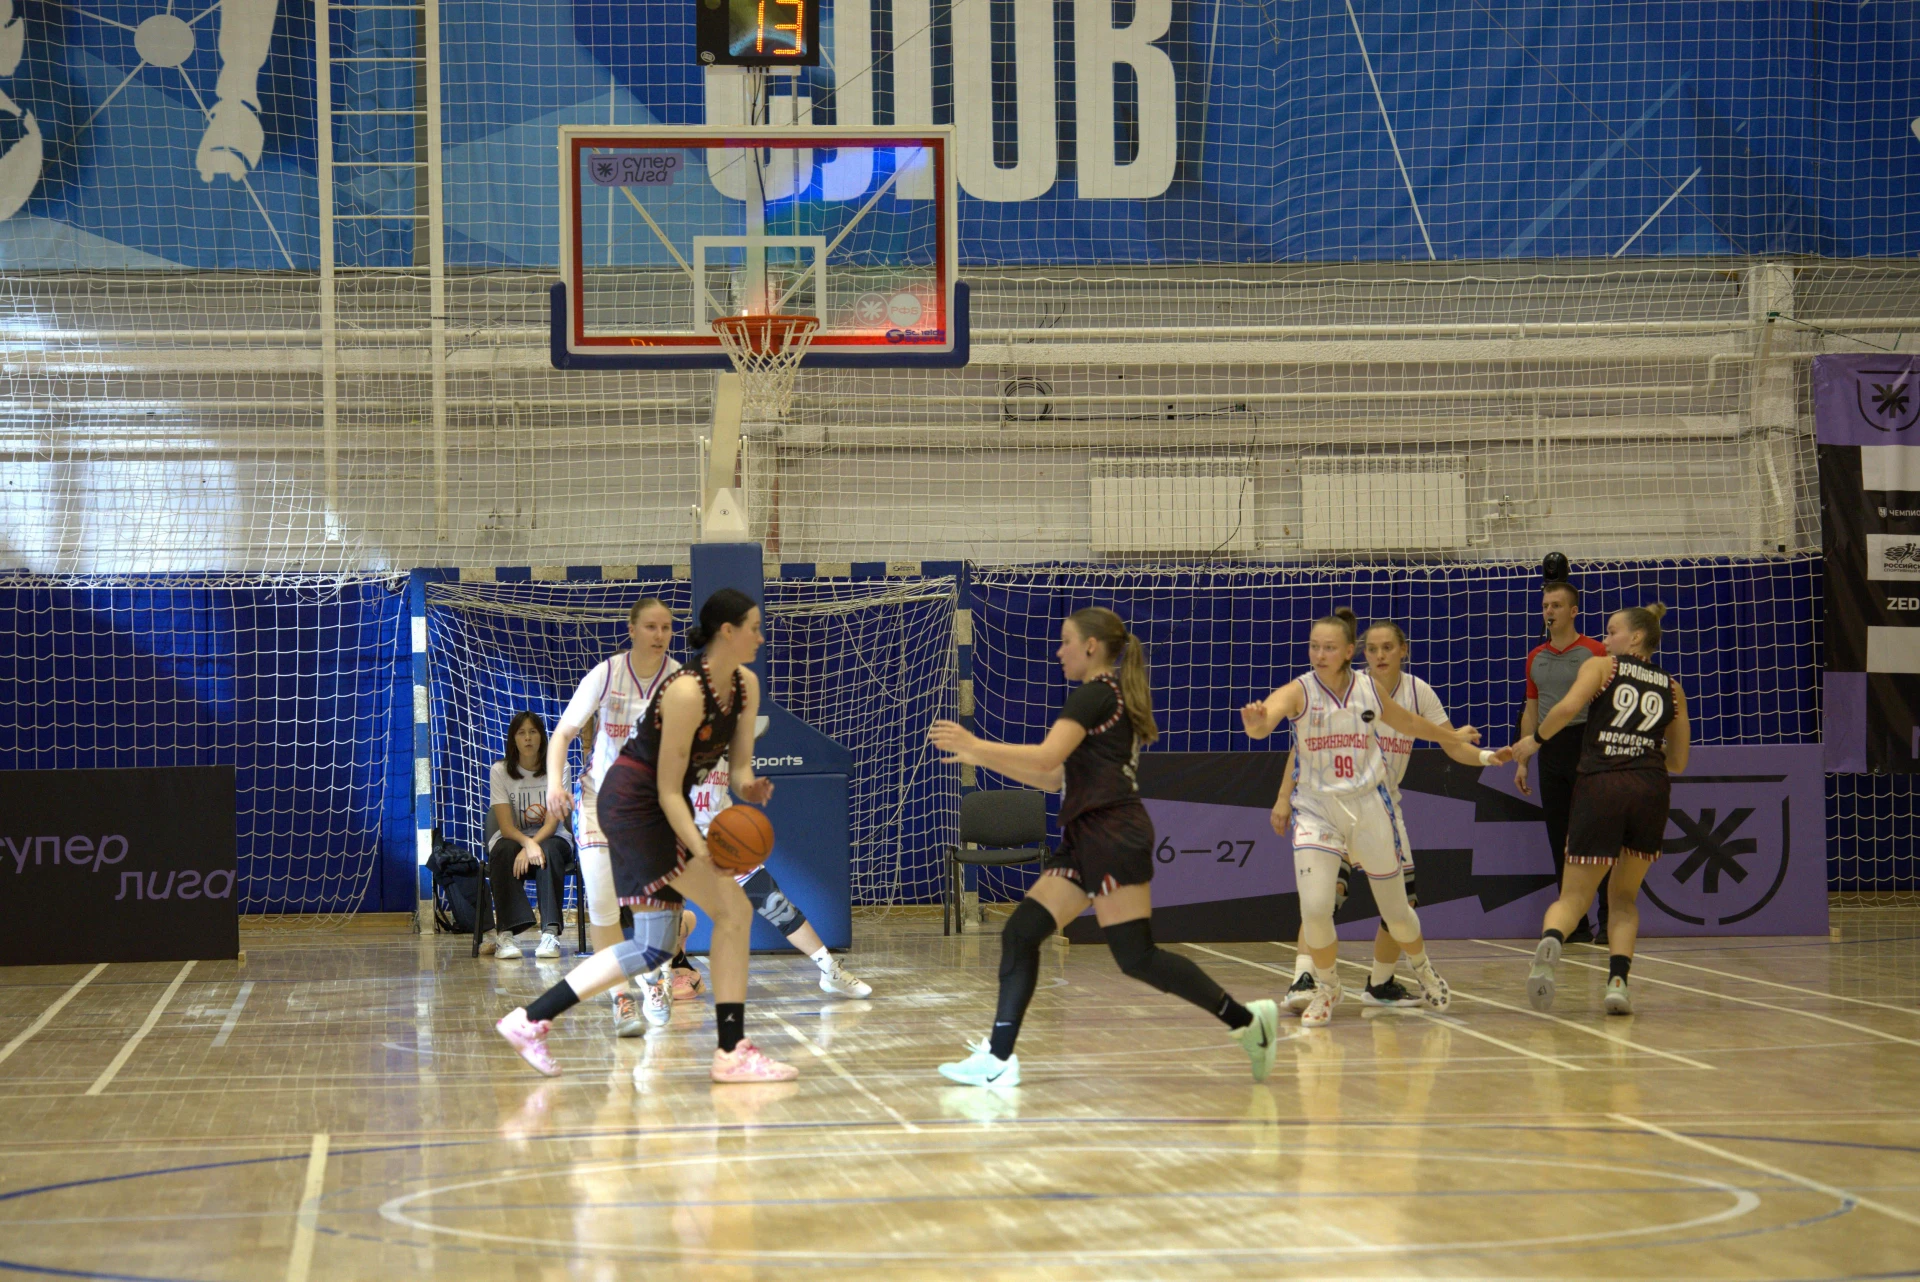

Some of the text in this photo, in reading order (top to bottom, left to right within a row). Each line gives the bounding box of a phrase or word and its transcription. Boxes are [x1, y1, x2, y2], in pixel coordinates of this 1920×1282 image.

[756, 0, 803, 54] 13
[622, 156, 676, 172] супер
[623, 170, 668, 183] лига
[890, 306, 919, 315] РФБ
[1887, 597, 1920, 610] ZED
[1610, 683, 1664, 732] 99
[1334, 755, 1354, 778] 99
[694, 792, 710, 811] 44
[0, 834, 129, 874] упер
[115, 869, 237, 901] лига
